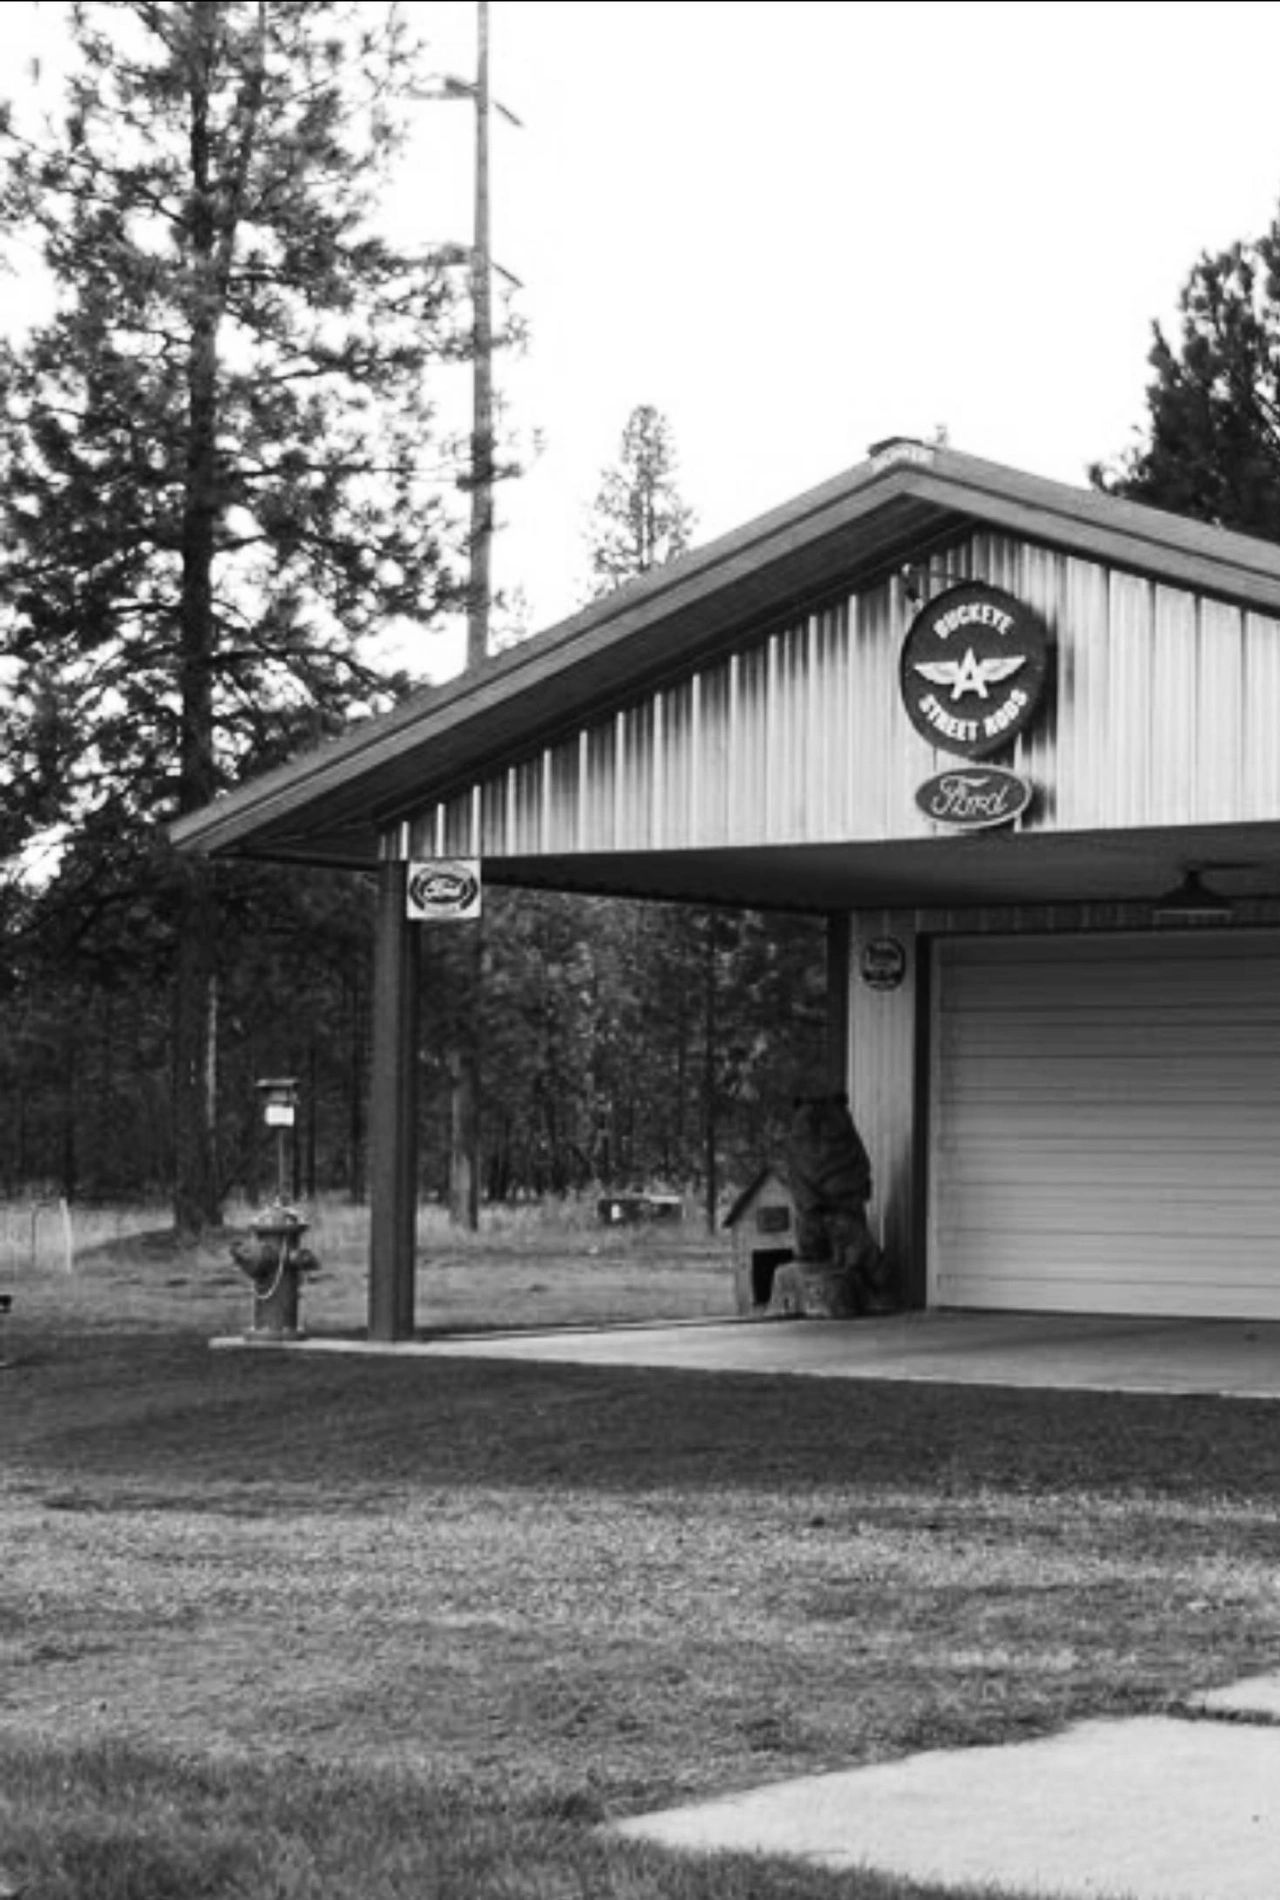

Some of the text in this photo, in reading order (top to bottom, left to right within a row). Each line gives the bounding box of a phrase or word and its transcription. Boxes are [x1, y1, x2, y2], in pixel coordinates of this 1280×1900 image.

[932, 602, 1015, 640] BUCKEYE
[918, 693, 978, 742] STREET
[929, 774, 1011, 817] Ford
